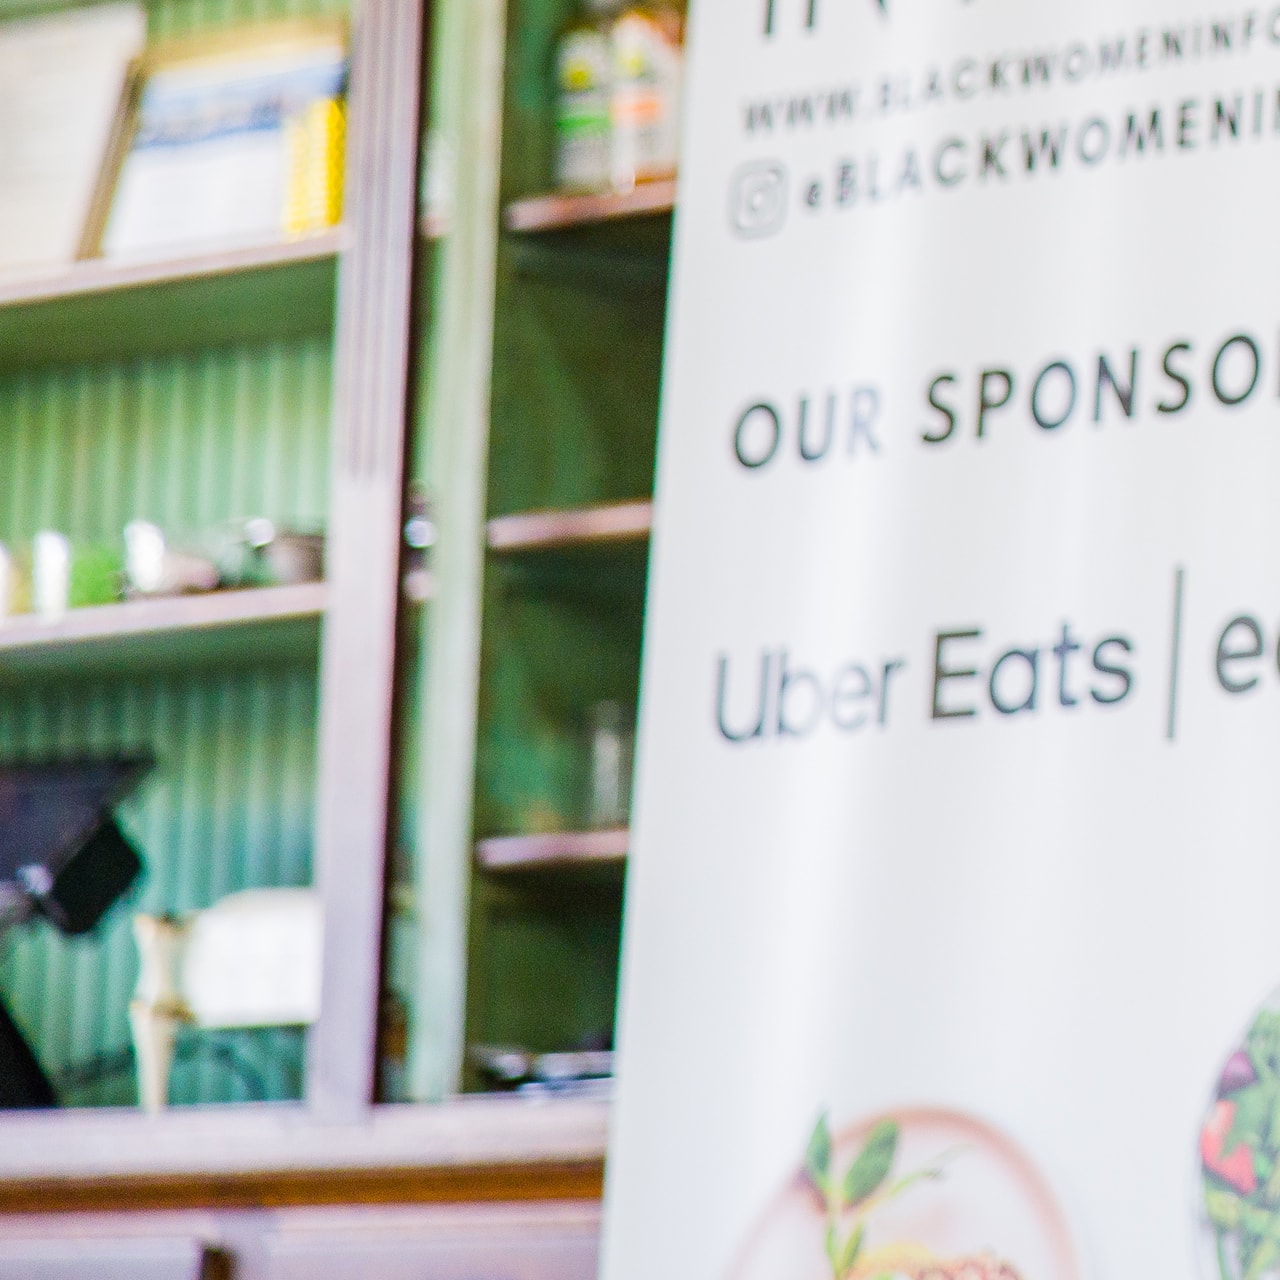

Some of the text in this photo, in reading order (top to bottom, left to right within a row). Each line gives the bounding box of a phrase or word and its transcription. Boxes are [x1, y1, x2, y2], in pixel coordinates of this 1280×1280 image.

[730, 387, 882, 475] OUR
[711, 648, 905, 747] Uber
[926, 623, 1136, 724] Eats
